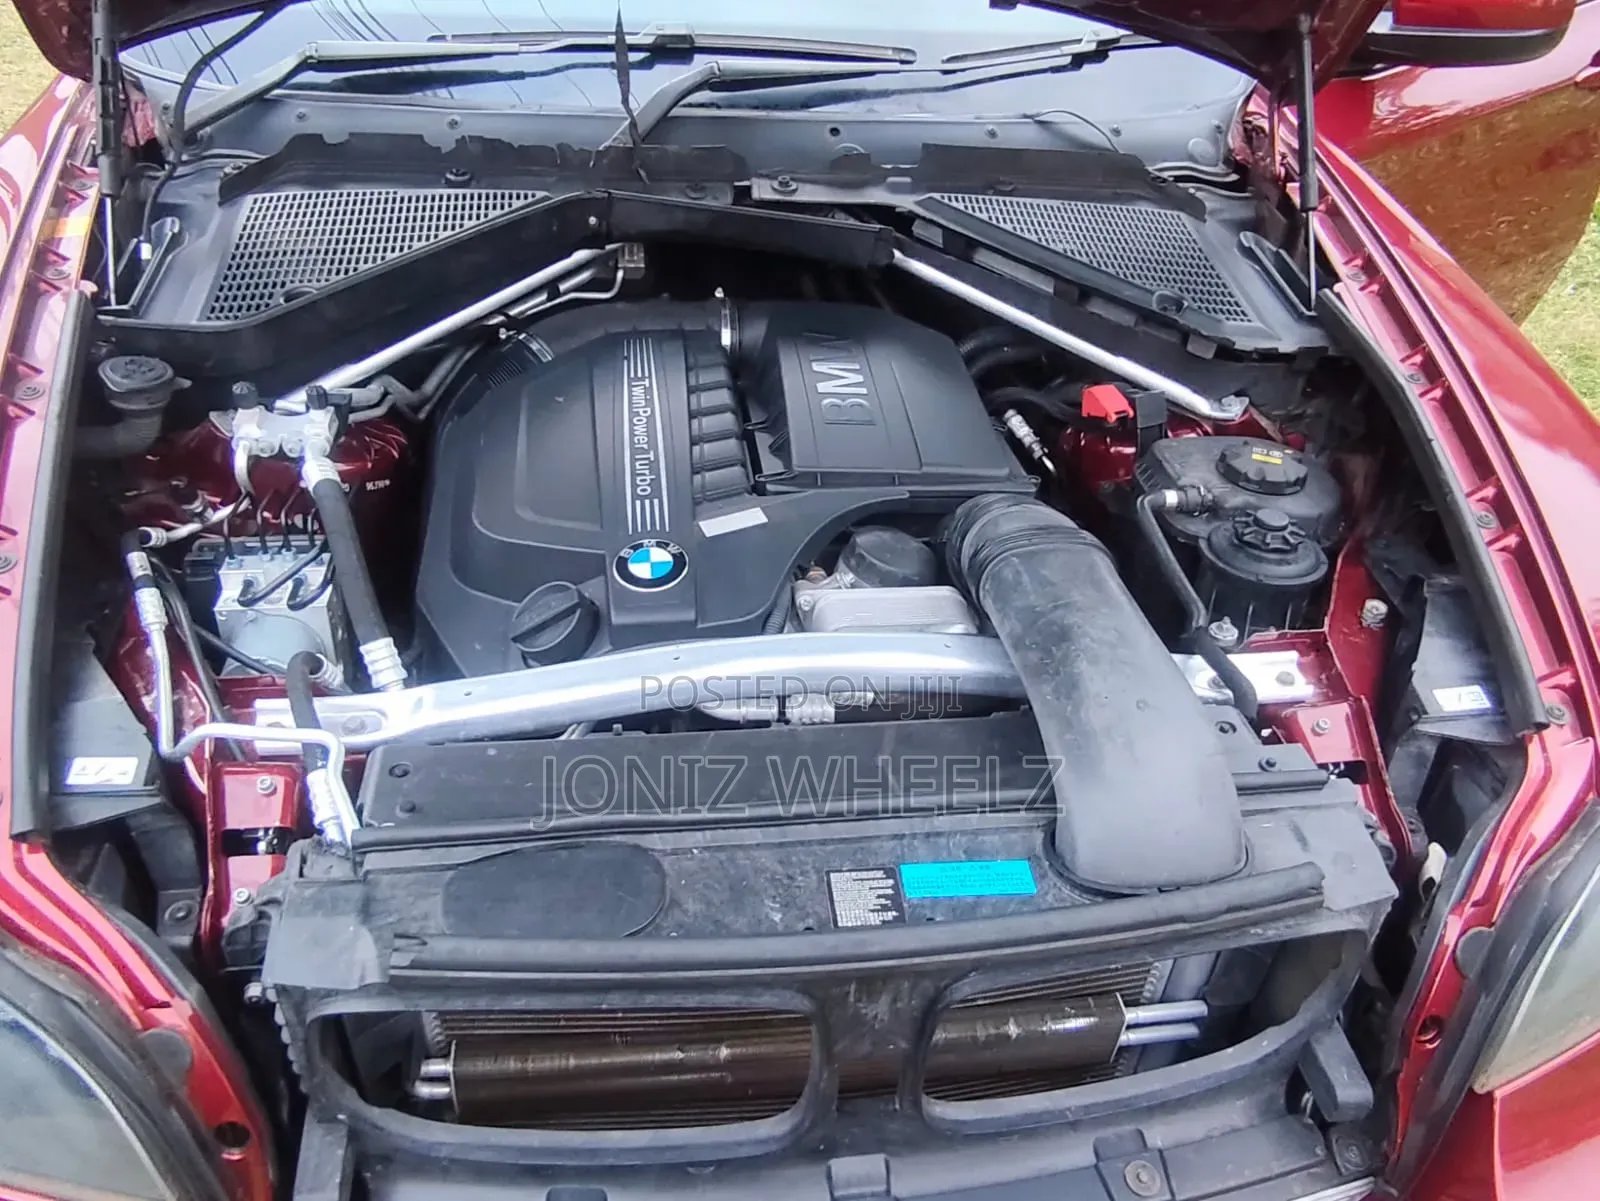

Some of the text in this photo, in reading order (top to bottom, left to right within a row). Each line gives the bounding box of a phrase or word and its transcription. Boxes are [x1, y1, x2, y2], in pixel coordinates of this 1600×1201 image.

[802, 331, 876, 425] BMW
[631, 378, 655, 496] TwinPower Turbo
[619, 540, 682, 559] BMW
